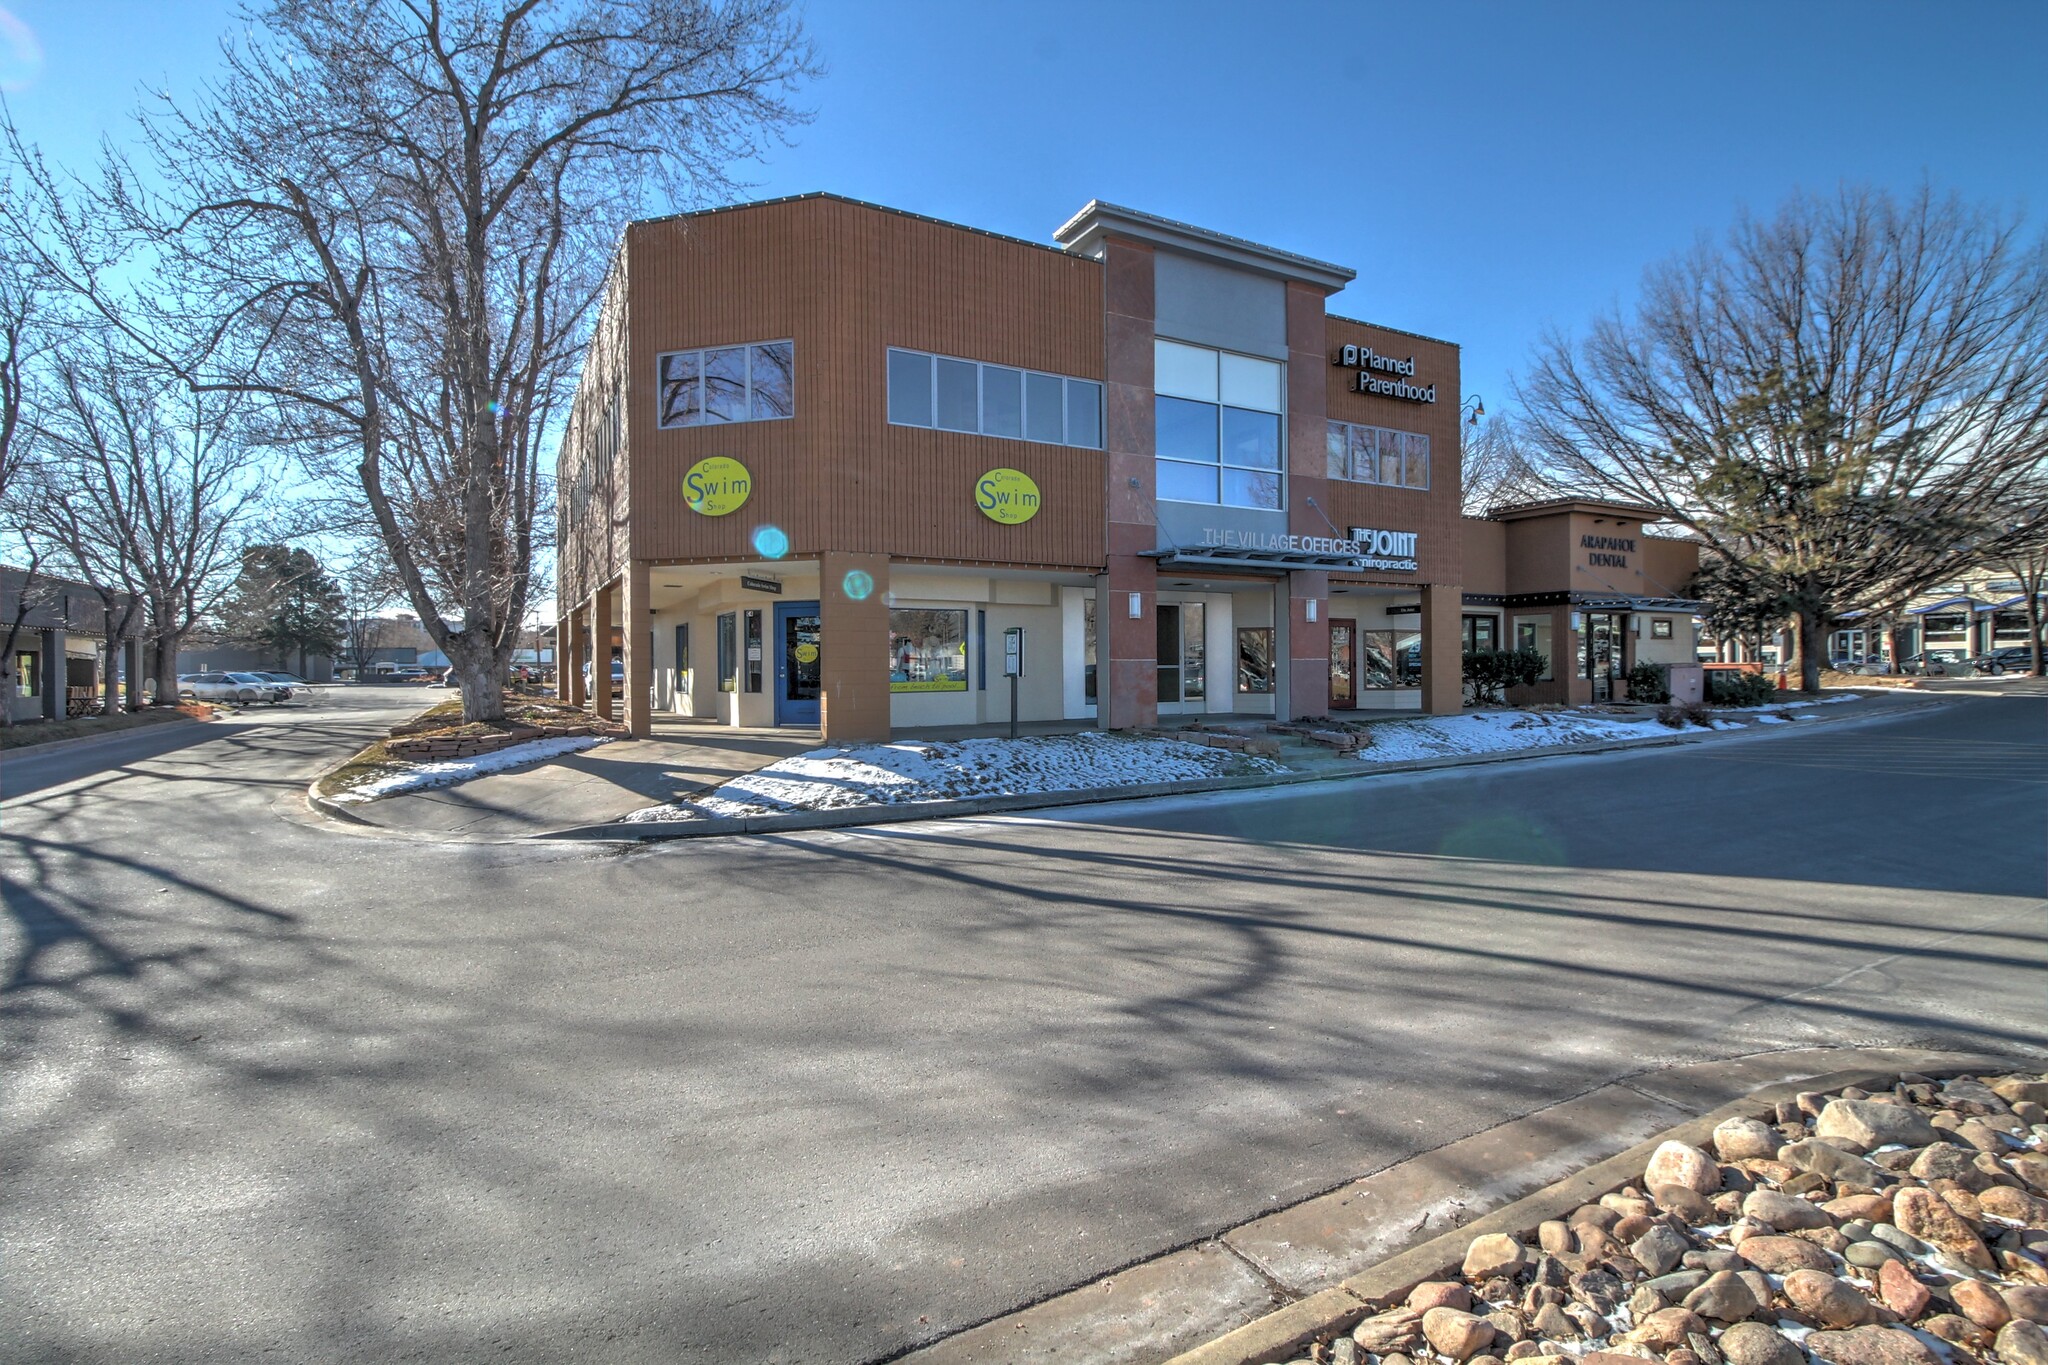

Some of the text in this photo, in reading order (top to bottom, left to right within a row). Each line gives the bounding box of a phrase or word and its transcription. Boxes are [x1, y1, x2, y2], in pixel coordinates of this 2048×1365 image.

[1360, 347, 1414, 376] Planned
[1360, 371, 1436, 403] Parenthood
[702, 462, 730, 473] Colorado
[994, 472, 1020, 482] Colorado
[686, 472, 748, 504] Swim
[980, 480, 1037, 509] Swim
[707, 500, 726, 511] Shop
[1000, 508, 1018, 519] Shop
[1203, 528, 1360, 555] THE VILLAGE OFFICES
[1351, 528, 1418, 558] THE JOINT
[1580, 534, 1637, 552] ARAPAHOE
[1589, 552, 1628, 569] DENTAL
[797, 648, 817, 659] Swim
